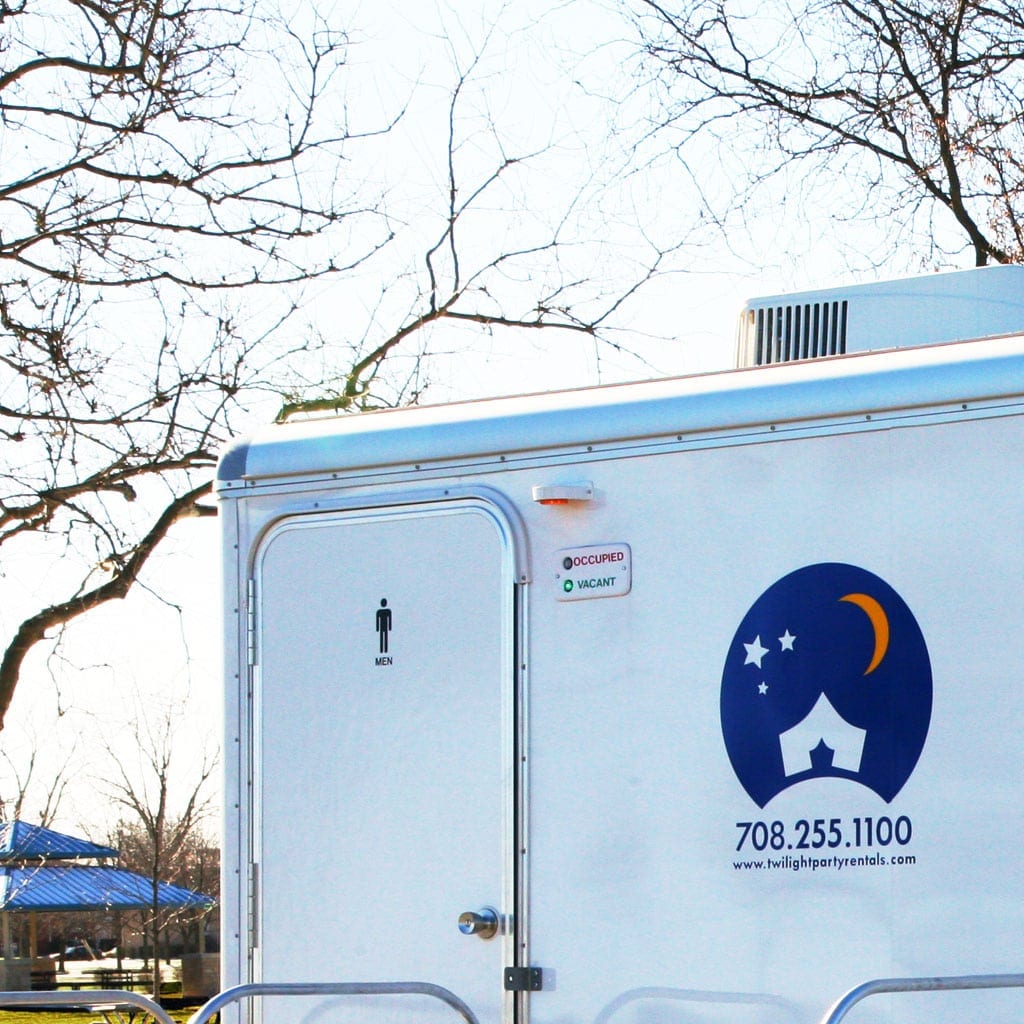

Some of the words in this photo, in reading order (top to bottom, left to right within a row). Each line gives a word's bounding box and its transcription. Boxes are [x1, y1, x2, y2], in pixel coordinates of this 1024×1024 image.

[573, 552, 624, 566] OCCUPIED
[577, 577, 616, 589] VACANT
[375, 656, 393, 666] MEN
[735, 815, 913, 852] 708.255.1100
[732, 853, 917, 871] www.twilightpartyrentals.com
